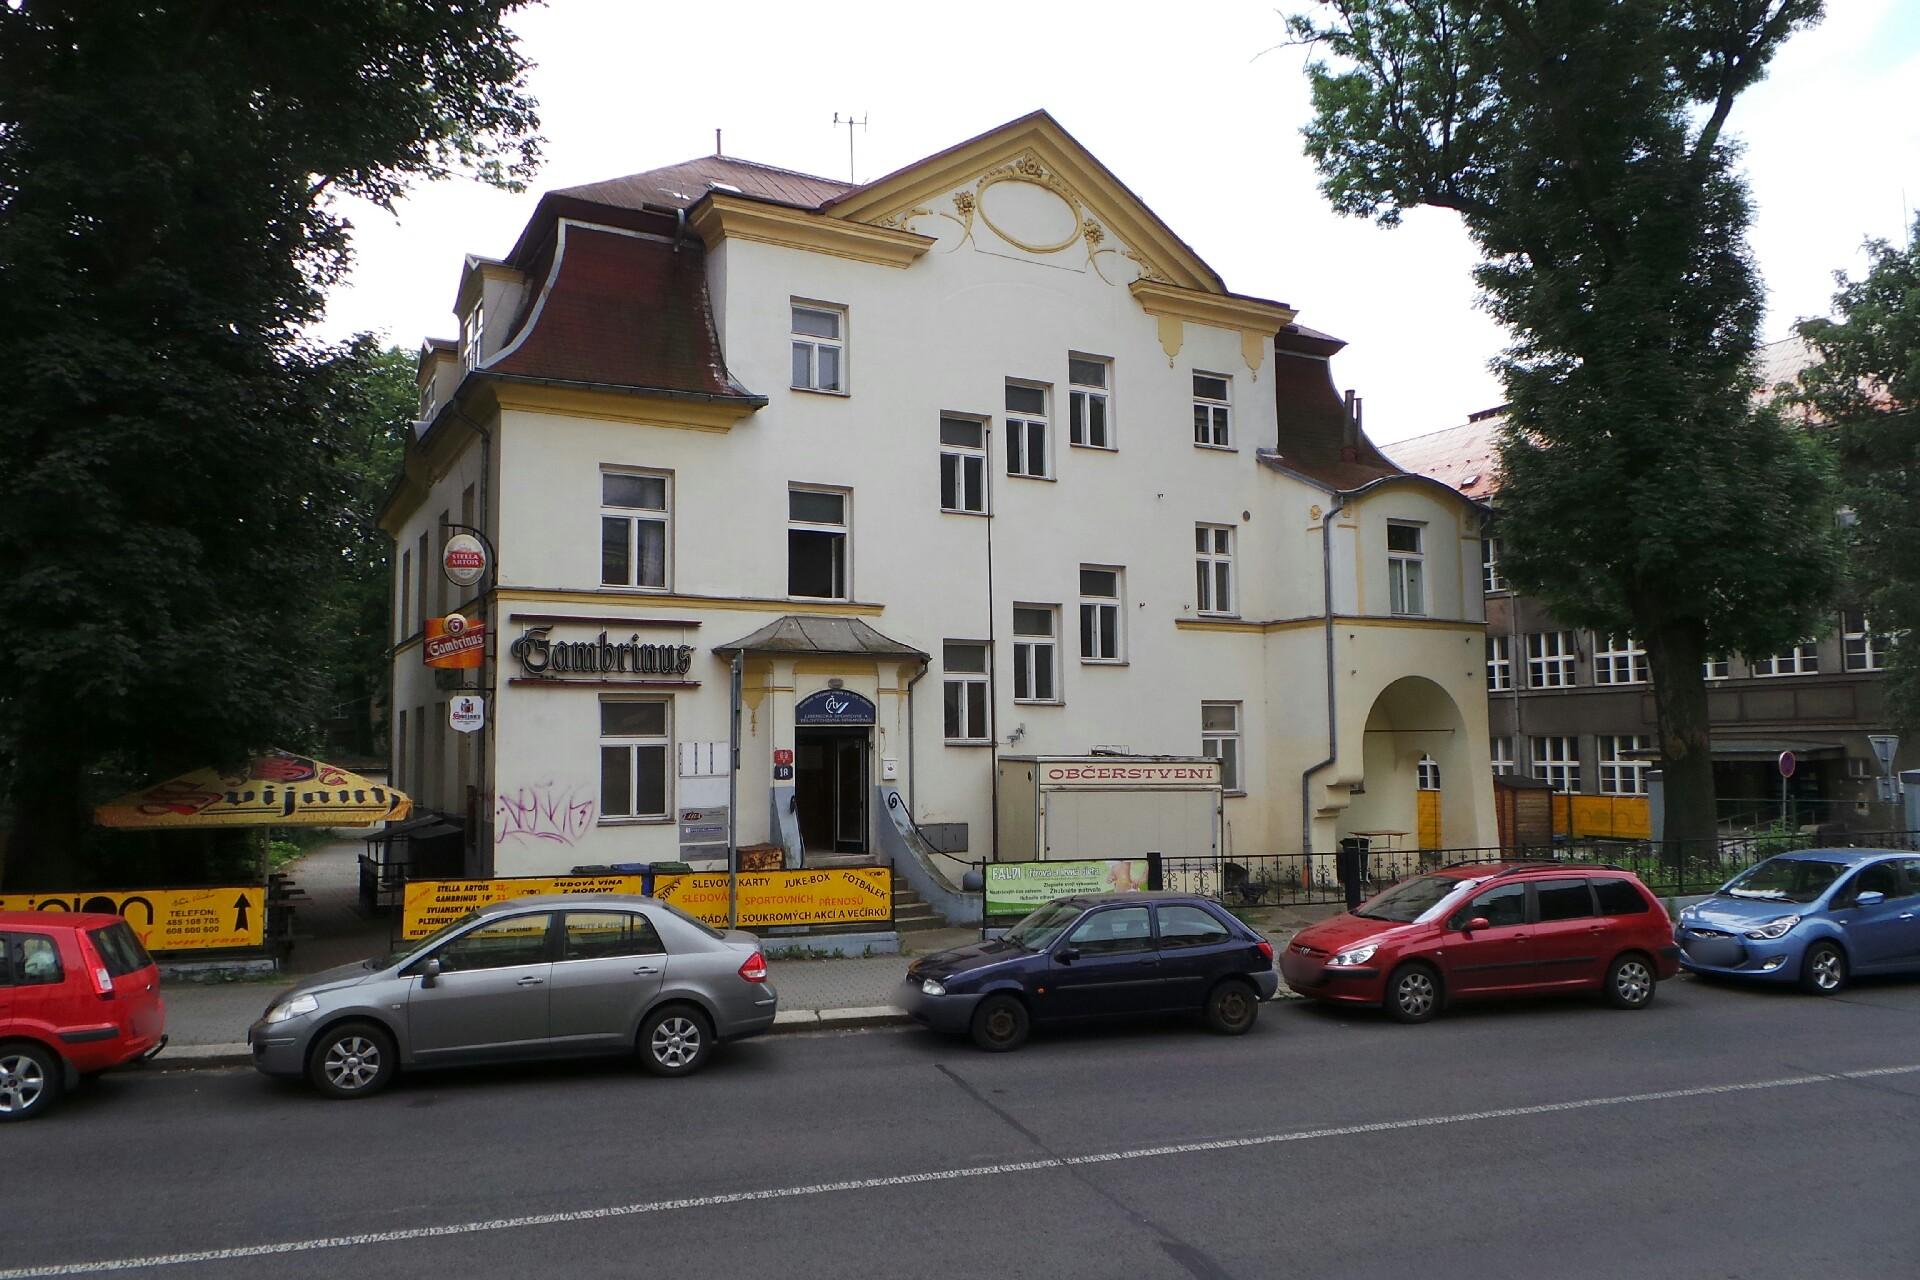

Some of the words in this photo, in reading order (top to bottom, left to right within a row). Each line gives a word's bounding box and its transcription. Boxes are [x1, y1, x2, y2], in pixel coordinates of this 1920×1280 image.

[429, 634, 483, 656] Gambrinus
[511, 625, 697, 675] Gambrinus
[1049, 765, 1213, 780] OBČERSTVENÍ
[784, 872, 831, 889] JUKE-BOX
[992, 866, 1021, 881] FALDI
[553, 878, 595, 887] SUDOVÁ
[598, 878, 623, 886] VÍNA
[692, 879, 731, 888] SLEVOV
[739, 878, 771, 887] KARTY
[842, 872, 888, 900] FOTBÁLEK
[436, 894, 477, 902] GAMBRINUS
[682, 891, 739, 903] SLEDOVÁÍ
[745, 893, 814, 906] SPORTOVNÍCH
[818, 896, 865, 907] PŘENOSŮ
[742, 909, 812, 924] SOUKROMÝCH
[814, 908, 837, 919] AKCÍ
[838, 909, 846, 918] A
[848, 906, 888, 918] VEČÍRKŮ
